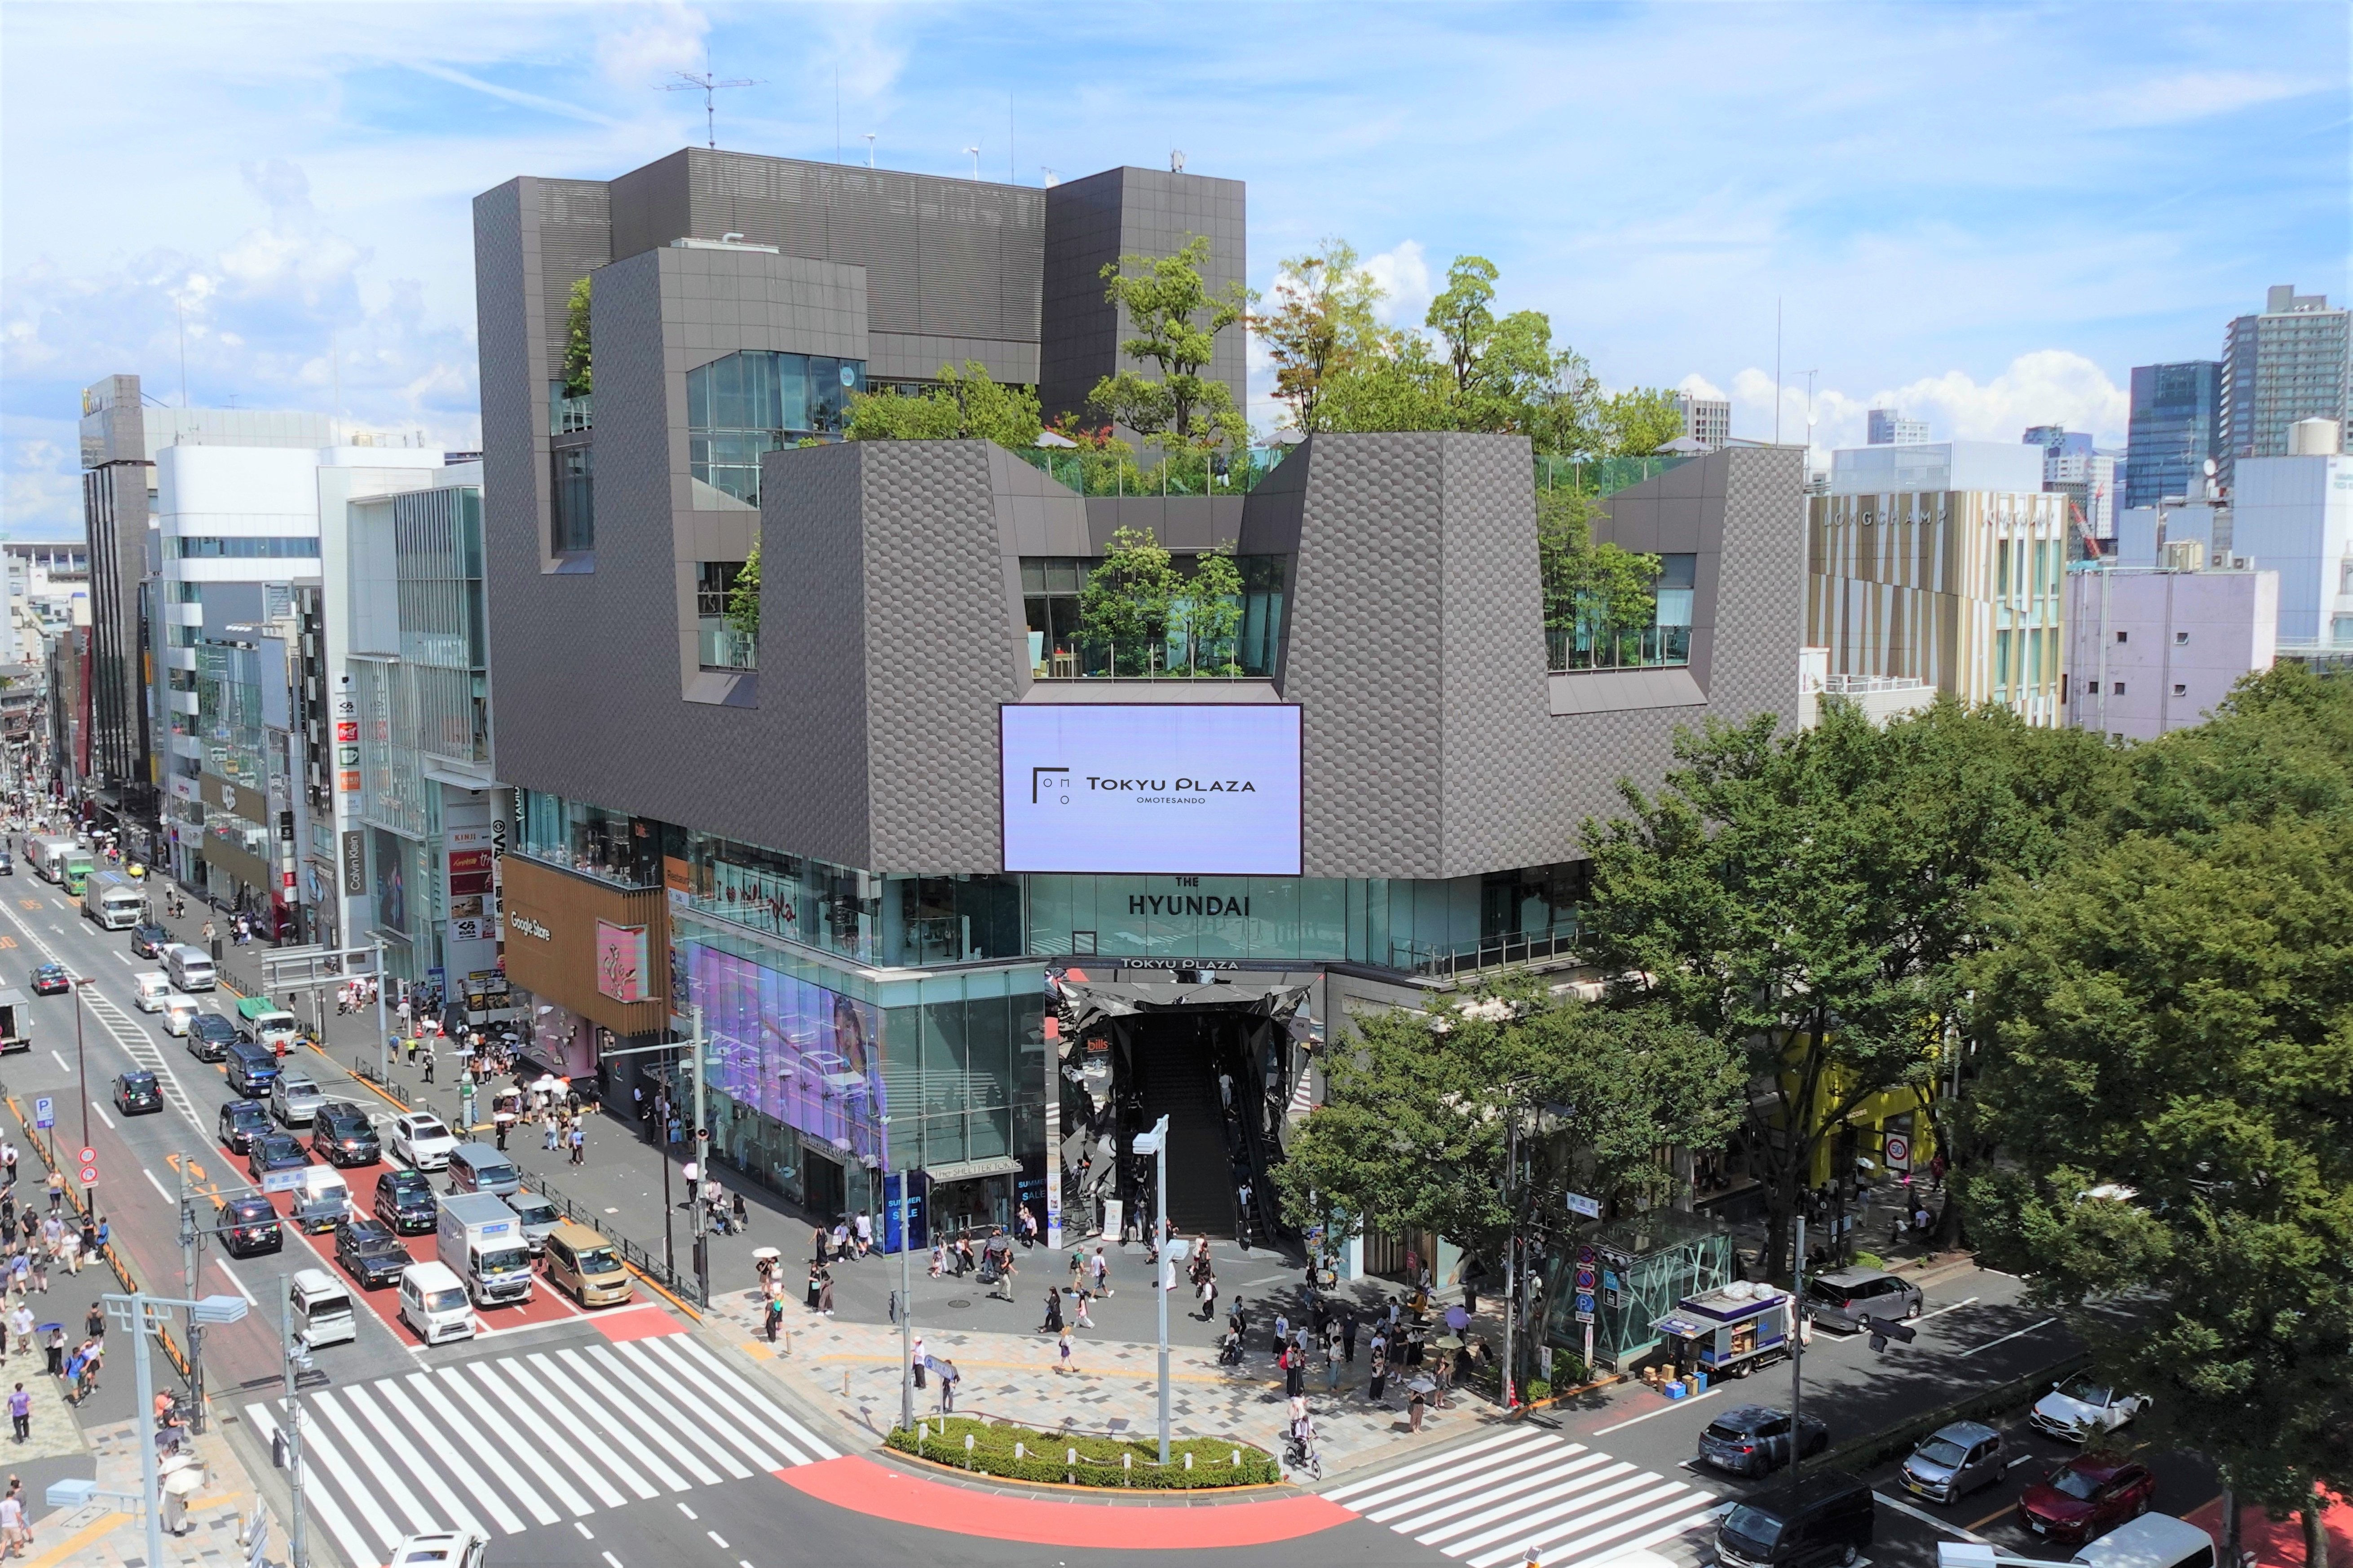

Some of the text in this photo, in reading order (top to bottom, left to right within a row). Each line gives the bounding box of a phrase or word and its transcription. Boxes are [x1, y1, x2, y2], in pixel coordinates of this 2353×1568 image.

[1823, 510, 1947, 527] LONGCHAMP
[1086, 777, 1256, 792] TOKYU PLAZA
[455, 833, 476, 841] KINJI
[348, 836, 360, 890] Calvin Klein
[1175, 877, 1199, 887] THE
[1129, 895, 1249, 916] HYUNDAI
[511, 911, 551, 941] Google Store
[1121, 958, 1239, 969] TOKYU PLAZA
[1087, 1039, 1108, 1051] bills
[39, 1100, 49, 1112] P
[1891, 1145, 1903, 1155] 50
[995, 1159, 1022, 1170] TOKYO
[1022, 1190, 1046, 1201] SALE
[1580, 1301, 1587, 1313] P
